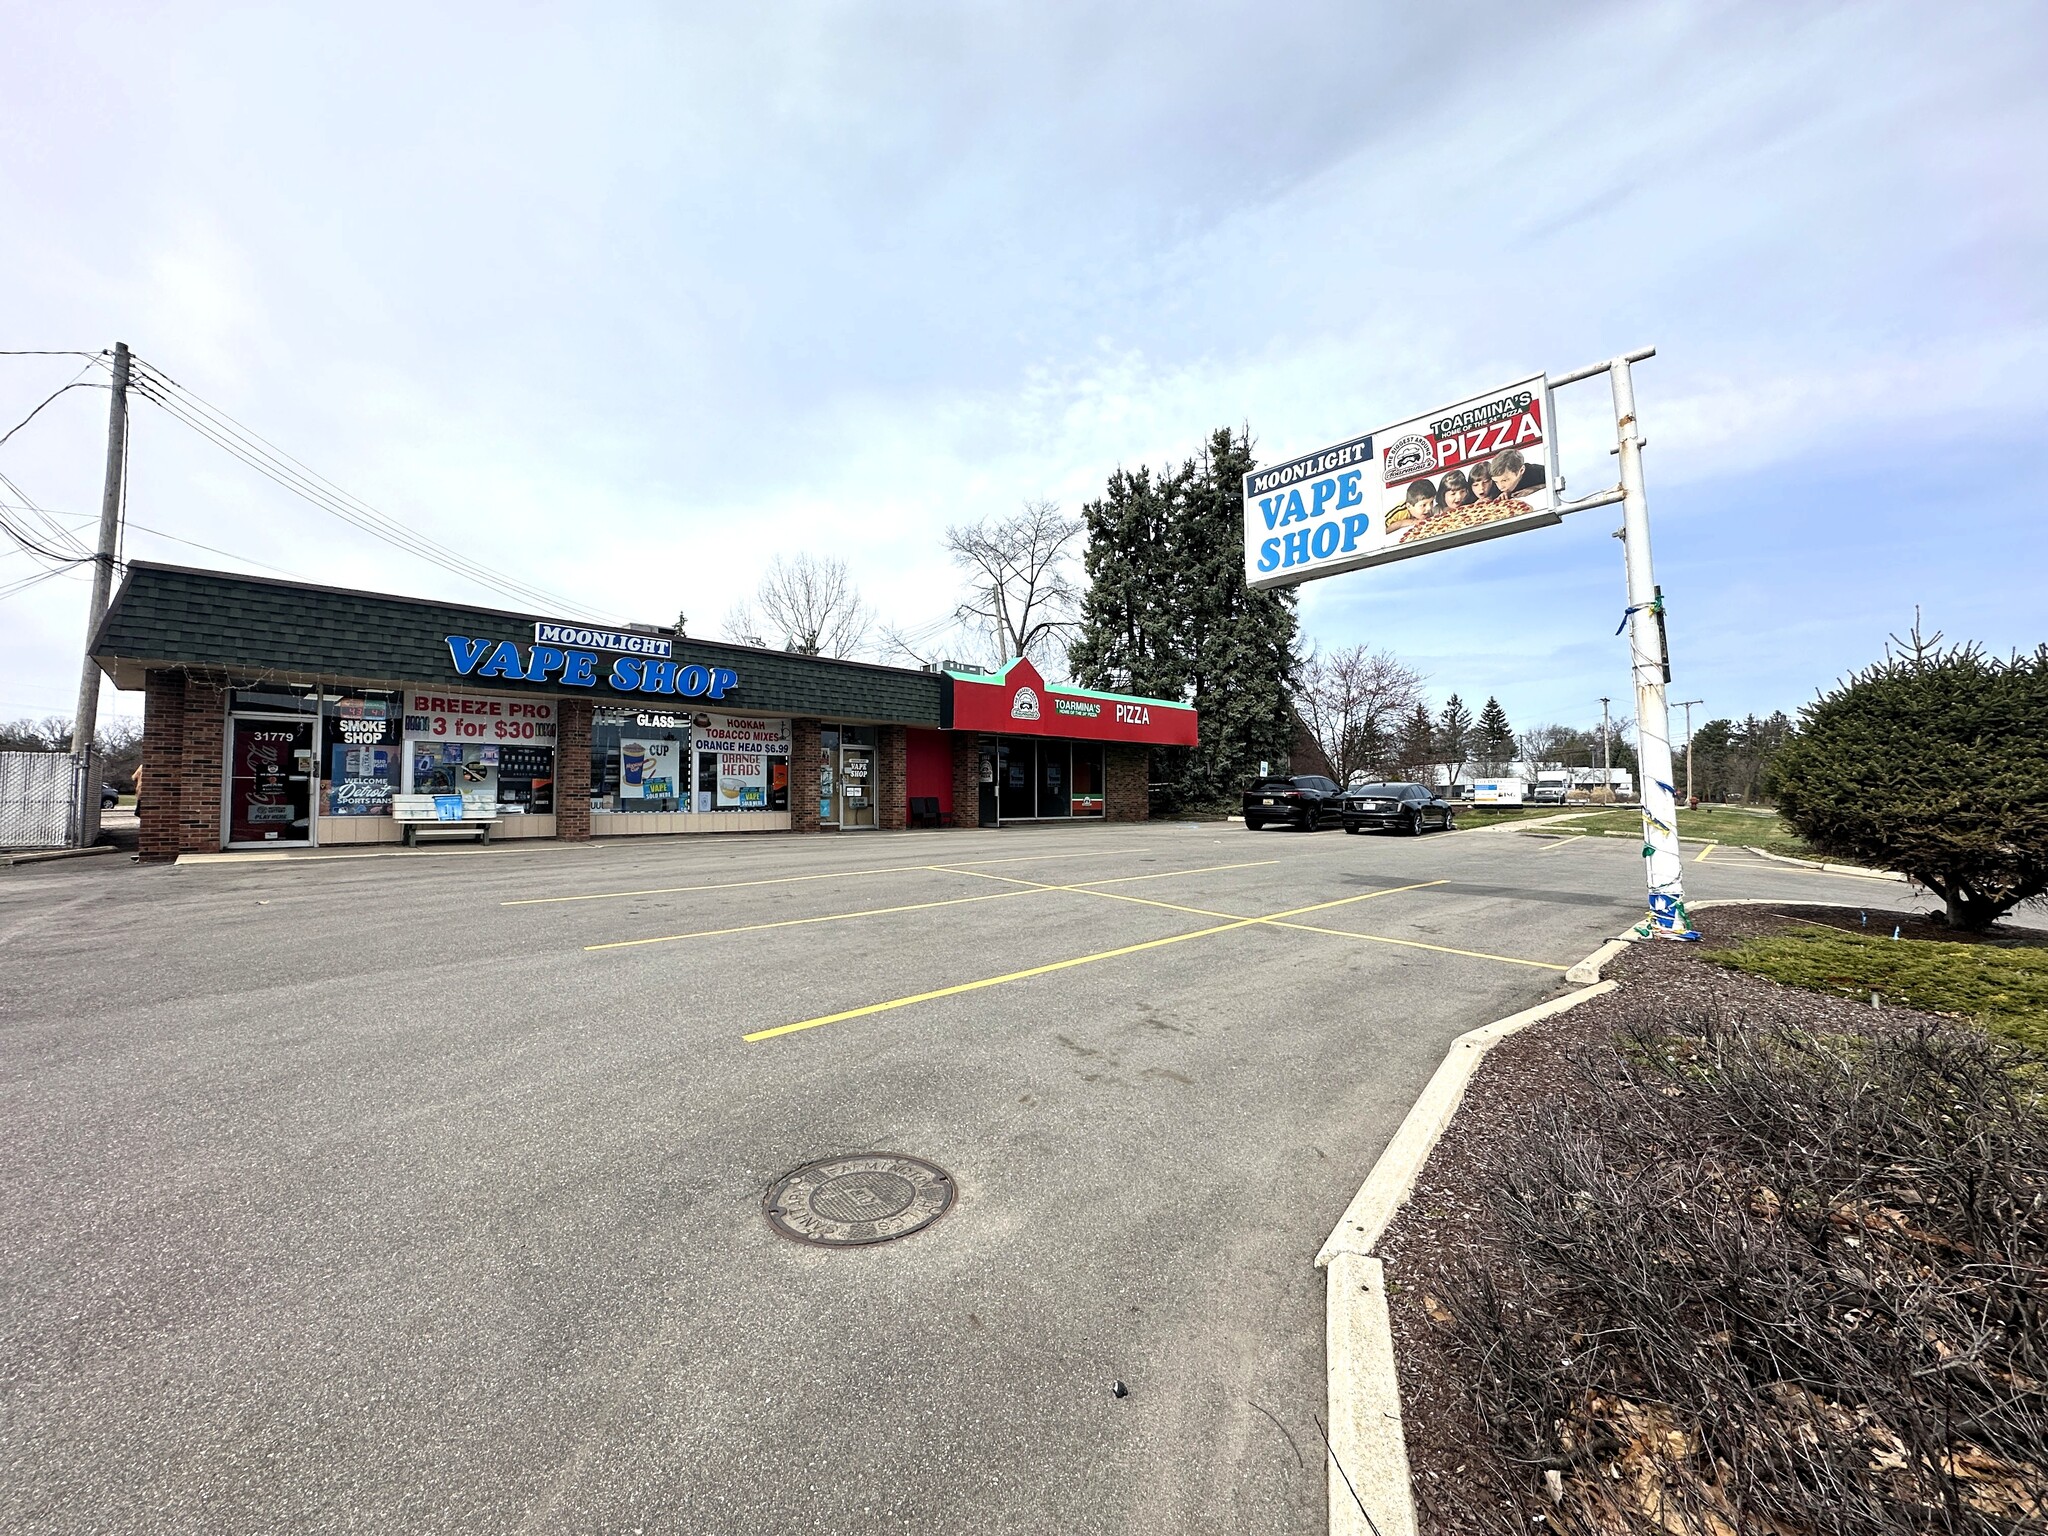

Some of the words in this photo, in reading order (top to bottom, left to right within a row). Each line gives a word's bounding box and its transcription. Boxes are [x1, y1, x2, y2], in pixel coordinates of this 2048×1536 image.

[1431, 392, 1531, 435] TOARMINA'S
[1441, 428, 1461, 439] HOME
[1462, 425, 1473, 433] OF
[1473, 419, 1488, 428] THE
[1501, 408, 1523, 419] PIZZA
[1391, 437, 1414, 455] BIGGEST
[1414, 437, 1432, 457] AROUND
[1436, 412, 1542, 468] PIZZA
[1253, 442, 1367, 494] MOONLIGHT
[1258, 469, 1363, 531] VAPE
[1257, 513, 1370, 573] SHOP
[542, 626, 669, 655] MOONLIGHT
[444, 635, 598, 687] VAPE
[608, 657, 739, 700] SHOP
[414, 696, 502, 716] BREEZE
[509, 703, 551, 719] PRO
[1055, 699, 1101, 714] TOARMINA'S
[636, 713, 675, 729] GLASS
[1116, 704, 1150, 725] PIZZA
[339, 719, 387, 733] SMOKE
[432, 717, 447, 736] 3
[455, 717, 487, 737] for
[494, 720, 535, 740] $30
[727, 718, 765, 730] HOOKAH
[254, 731, 294, 743] 31779
[344, 731, 383, 744] SHOP
[705, 728, 751, 740] TOBACCO
[752, 731, 779, 742] MIXES
[649, 744, 669, 757] CUP
[695, 739, 735, 752] ORANGE
[738, 743, 762, 753] HEAD
[764, 744, 789, 754] $6.99
[722, 753, 761, 764] ORANGE
[722, 764, 761, 776] HEADS
[850, 763, 867, 771] VAPE
[850, 770, 868, 778] SHOP
[344, 777, 388, 785] WELCOME
[649, 783, 667, 793] VAPE
[338, 783, 392, 799] Detroit
[745, 792, 760, 800] VAPE
